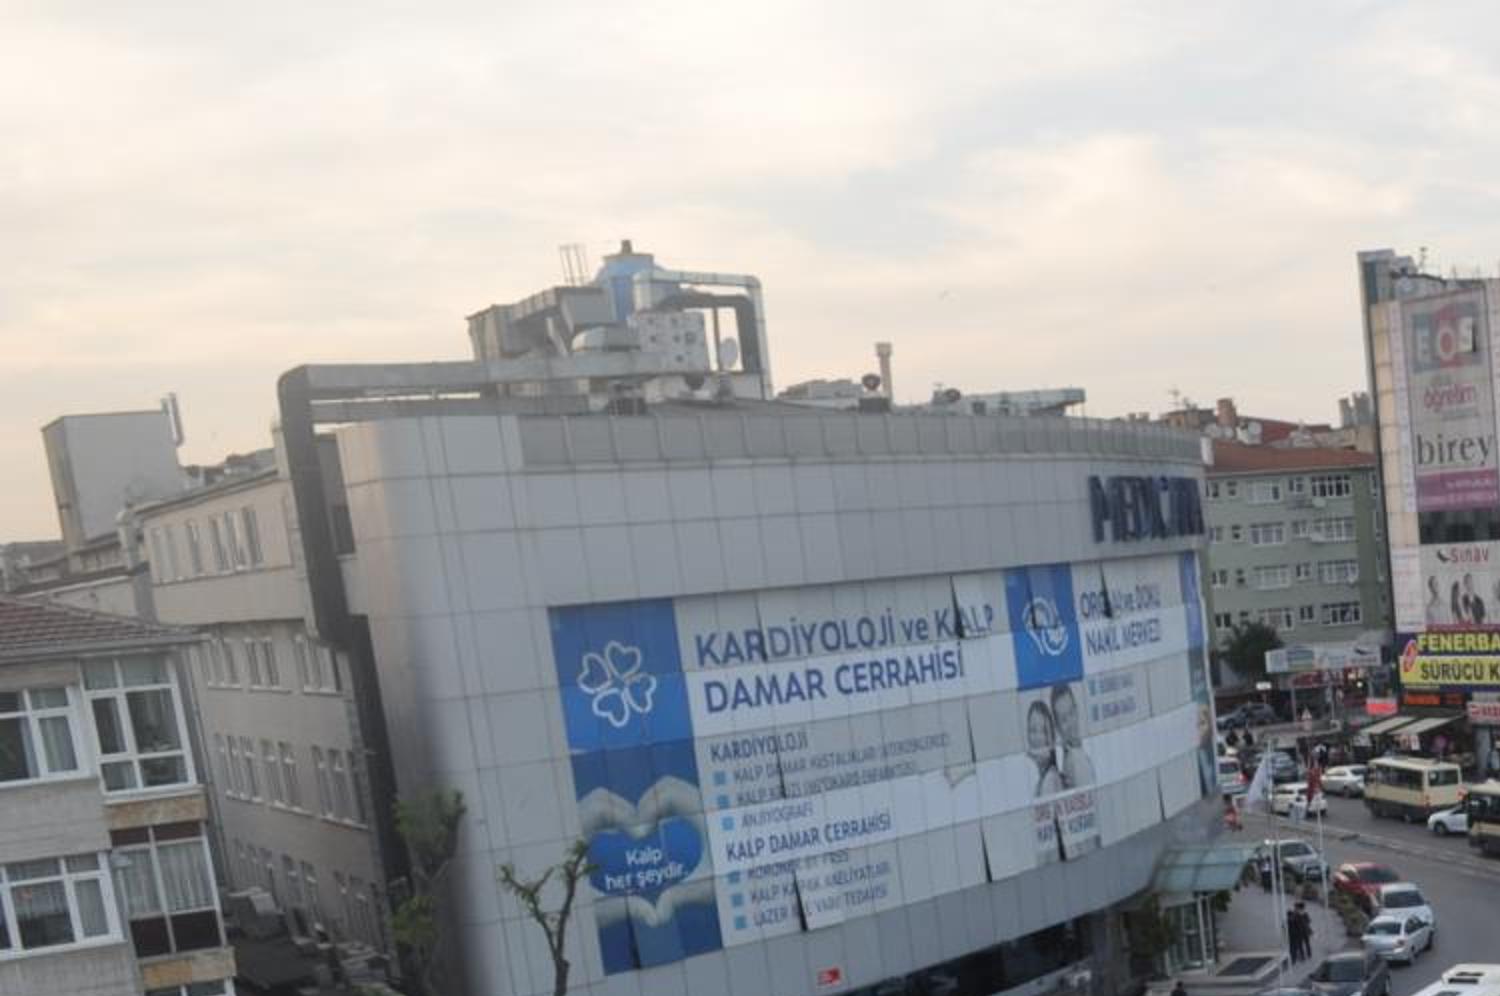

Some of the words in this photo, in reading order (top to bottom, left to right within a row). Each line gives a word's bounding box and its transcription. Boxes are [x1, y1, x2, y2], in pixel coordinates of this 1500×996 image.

[1417, 434, 1492, 467] birey
[694, 607, 897, 667] KARDİYOLOJİ
[900, 615, 930, 641] ve
[704, 668, 827, 714] DAMAR
[834, 641, 966, 695] CERRAHİSİ
[1420, 658, 1484, 682] SÜRÜCÜ
[625, 848, 662, 865] Kalp
[724, 838, 766, 862] KALP
[768, 828, 820, 854] DAMAR
[605, 873, 631, 890] her
